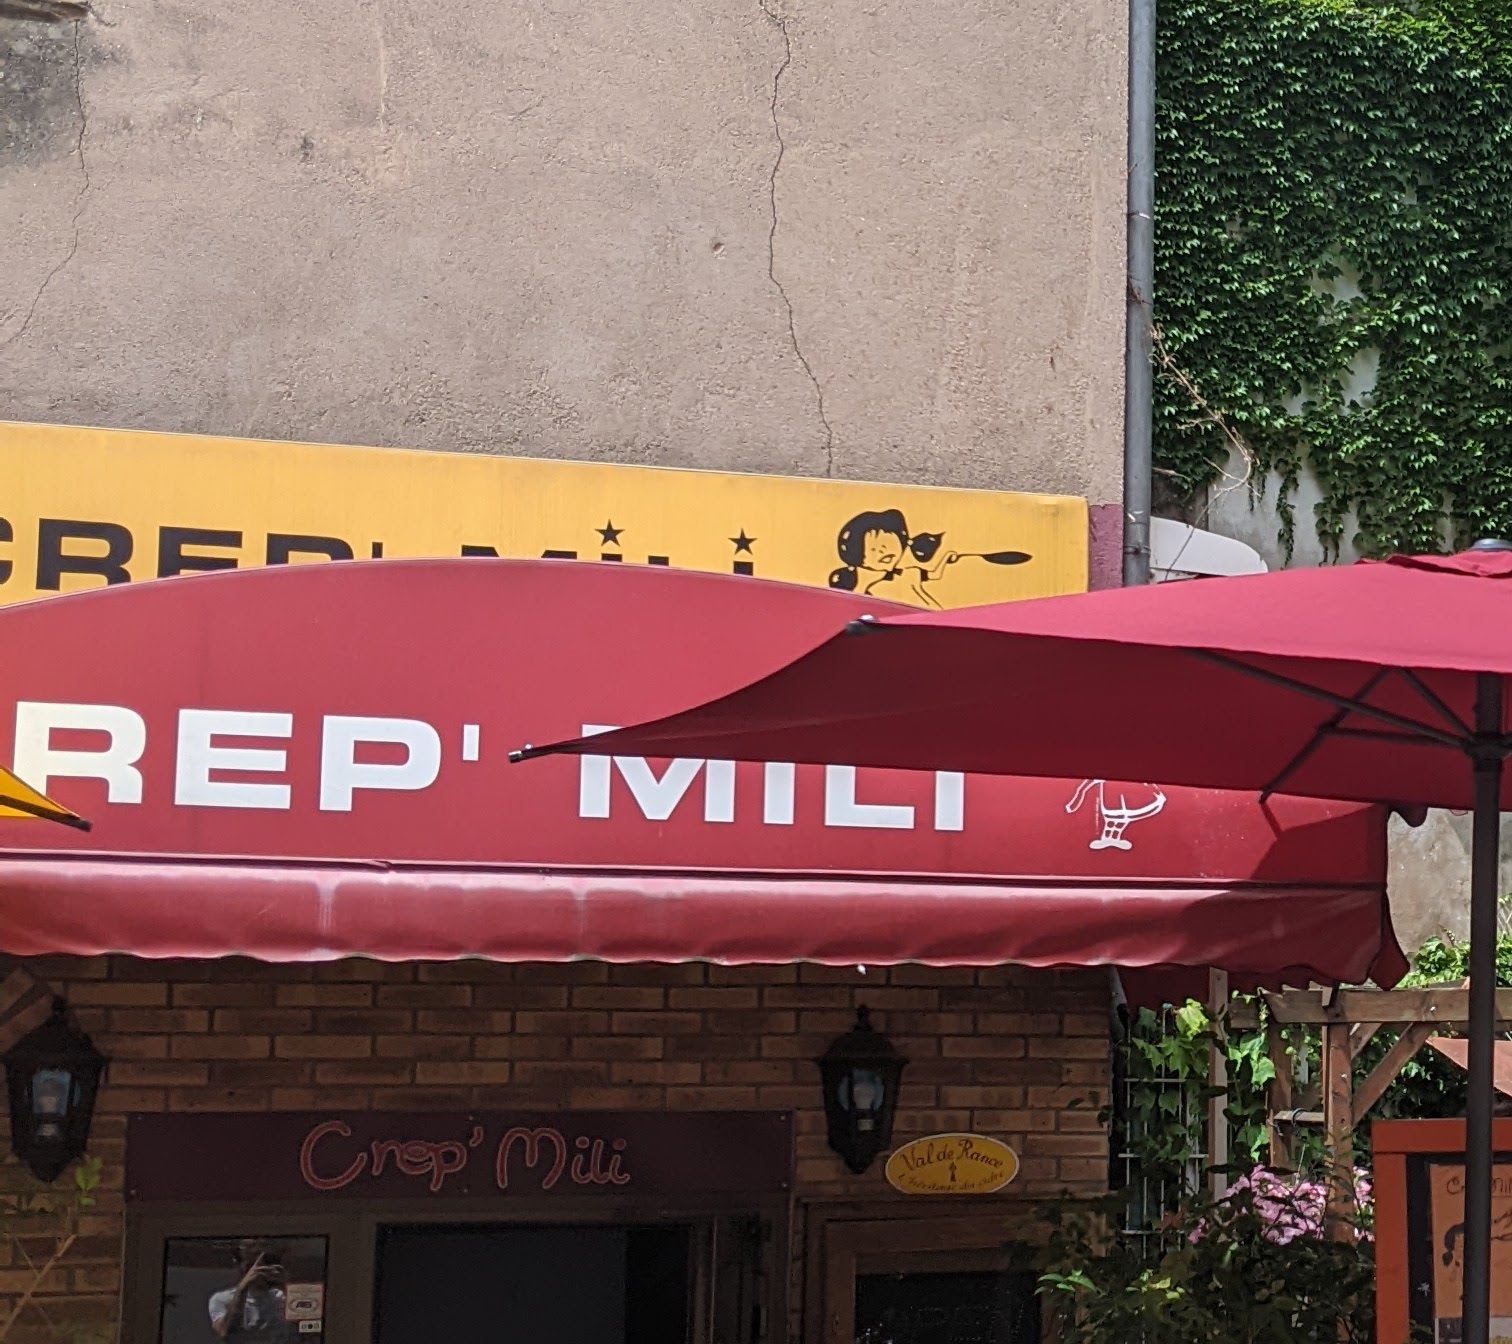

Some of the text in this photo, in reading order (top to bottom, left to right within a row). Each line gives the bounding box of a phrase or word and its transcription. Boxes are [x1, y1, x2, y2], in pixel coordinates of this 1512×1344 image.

[579, 724, 965, 831] MILI
[496, 1126, 631, 1190] Mili
[900, 1138, 1004, 1171] Val de Rance
